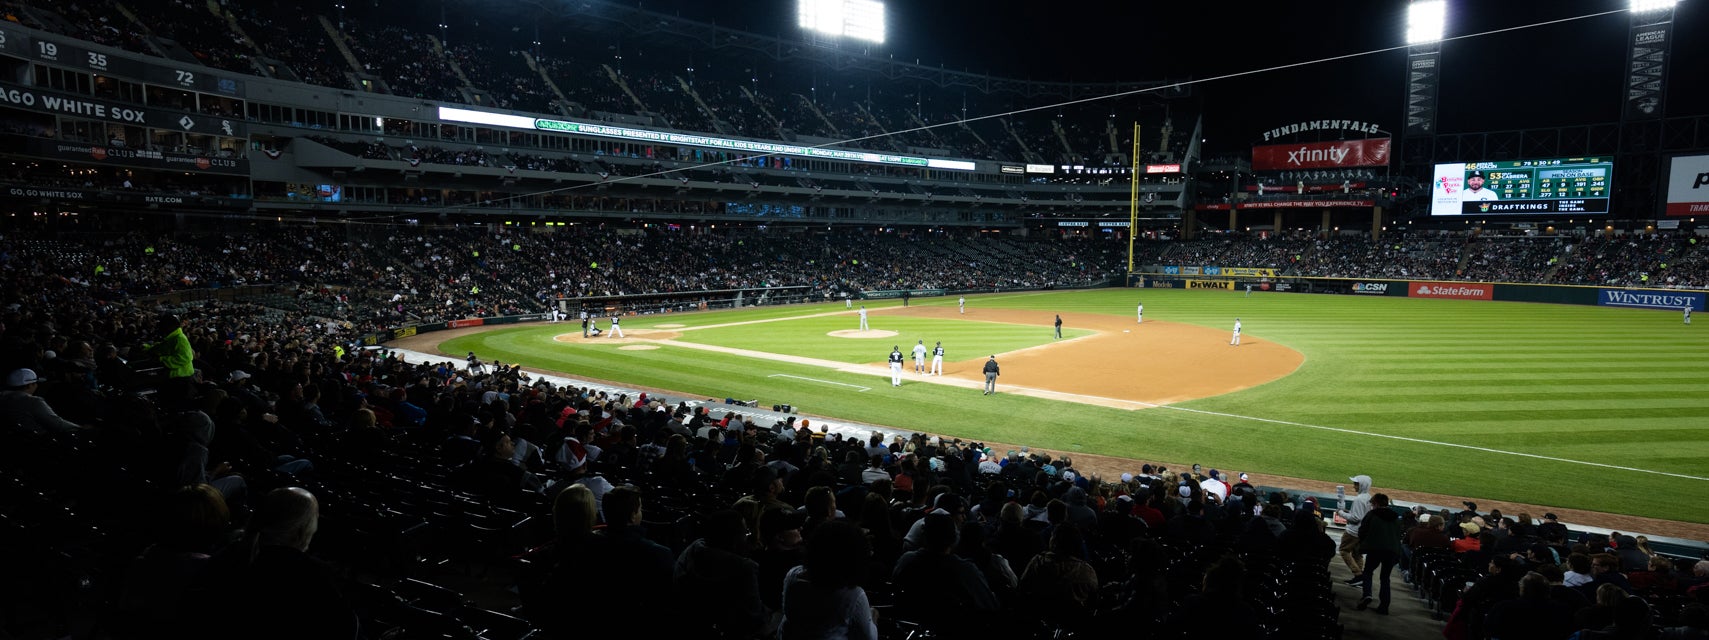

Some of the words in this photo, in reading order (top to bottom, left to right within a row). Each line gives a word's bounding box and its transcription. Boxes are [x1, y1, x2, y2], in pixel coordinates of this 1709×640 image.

[1635, 34, 1665, 42] LEAGUE
[38, 41, 58, 56] 19
[88, 52, 107, 66] 35
[175, 70, 194, 84] 72
[42, 95, 106, 117] WHITE
[111, 106, 145, 124] SOX
[578, 126, 622, 136] SUNGLASSES
[623, 130, 660, 139] PRESENTED
[1264, 120, 1379, 141] FUNDAMENTALS
[108, 149, 135, 158] CLUB
[1288, 146, 1350, 166] xfinity
[212, 159, 236, 167] CLUB
[10, 188, 25, 197] GO,
[26, 189, 38, 197] GO
[145, 196, 182, 204] RATE.COM
[1365, 283, 1388, 291] CSN
